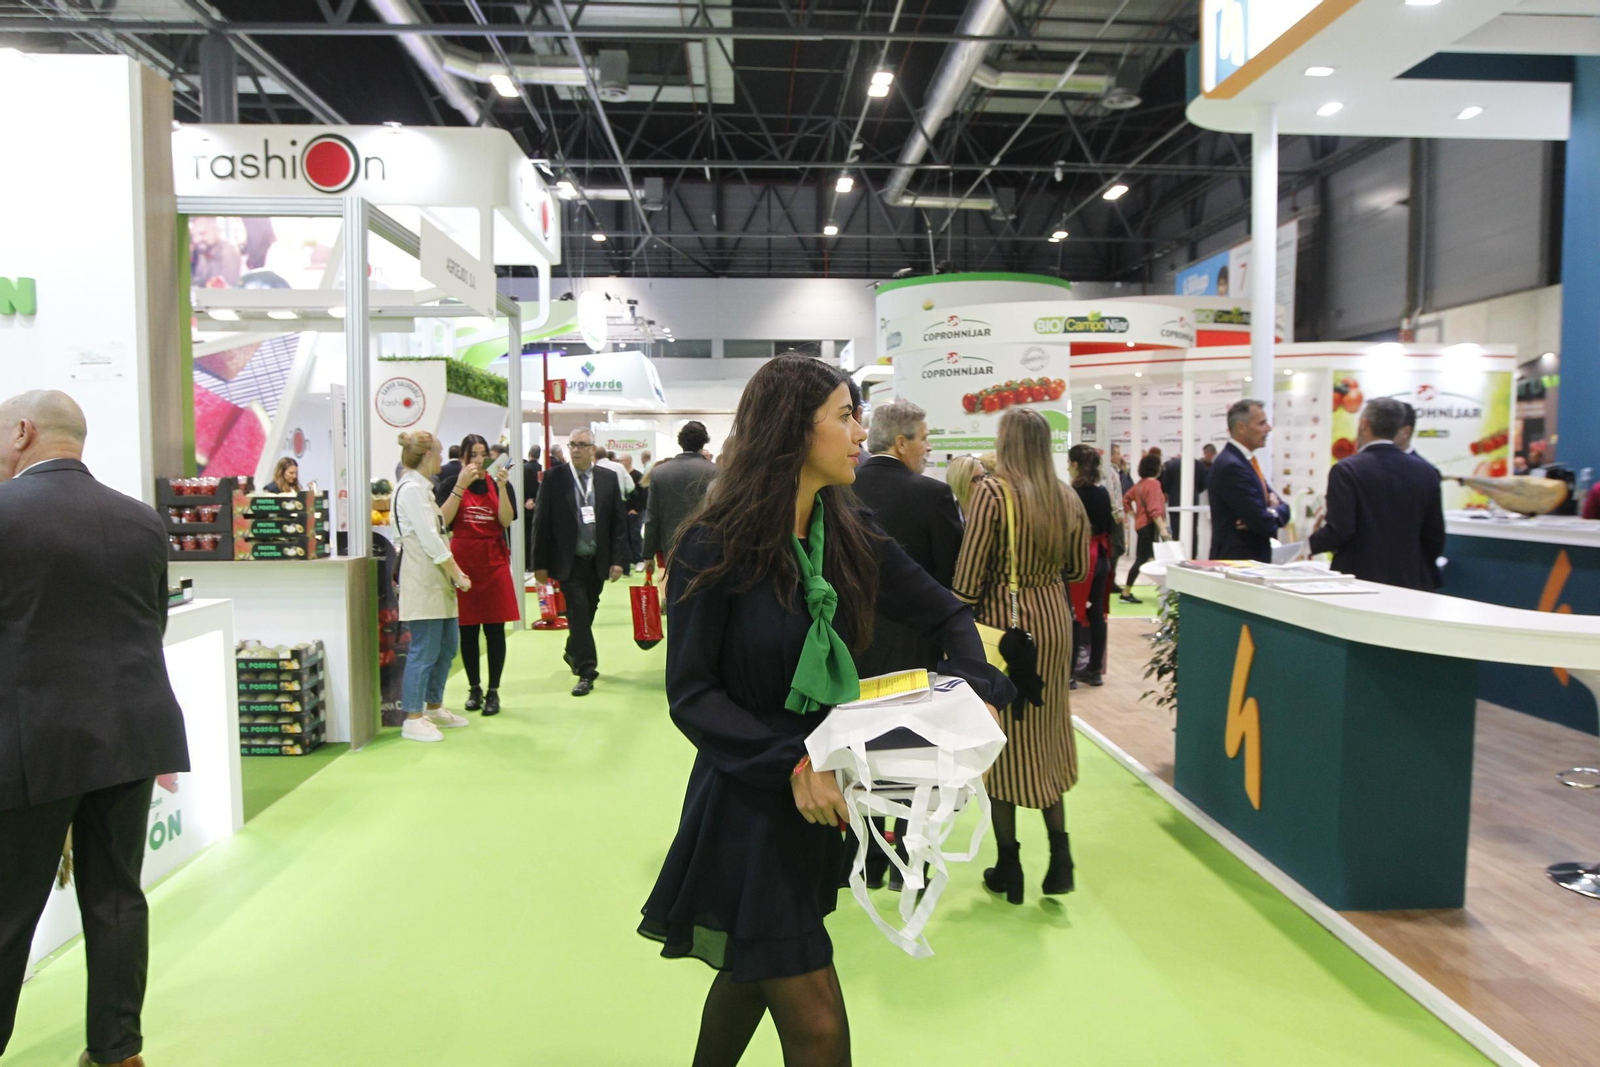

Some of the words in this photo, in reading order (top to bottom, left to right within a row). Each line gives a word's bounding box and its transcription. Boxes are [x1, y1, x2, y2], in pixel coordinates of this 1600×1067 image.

[1036, 319, 1060, 333] BIO
[923, 327, 991, 343] COPROHNÍJAR
[921, 364, 994, 380] COPROHNÍJAR
[566, 379, 623, 392] urgiverde
[248, 661, 277, 669] PORTÓN
[249, 682, 278, 690] PORTÓN
[250, 703, 279, 711] PORTÓN
[250, 724, 279, 733] PORTÓN
[251, 746, 280, 754] PORTÓN
